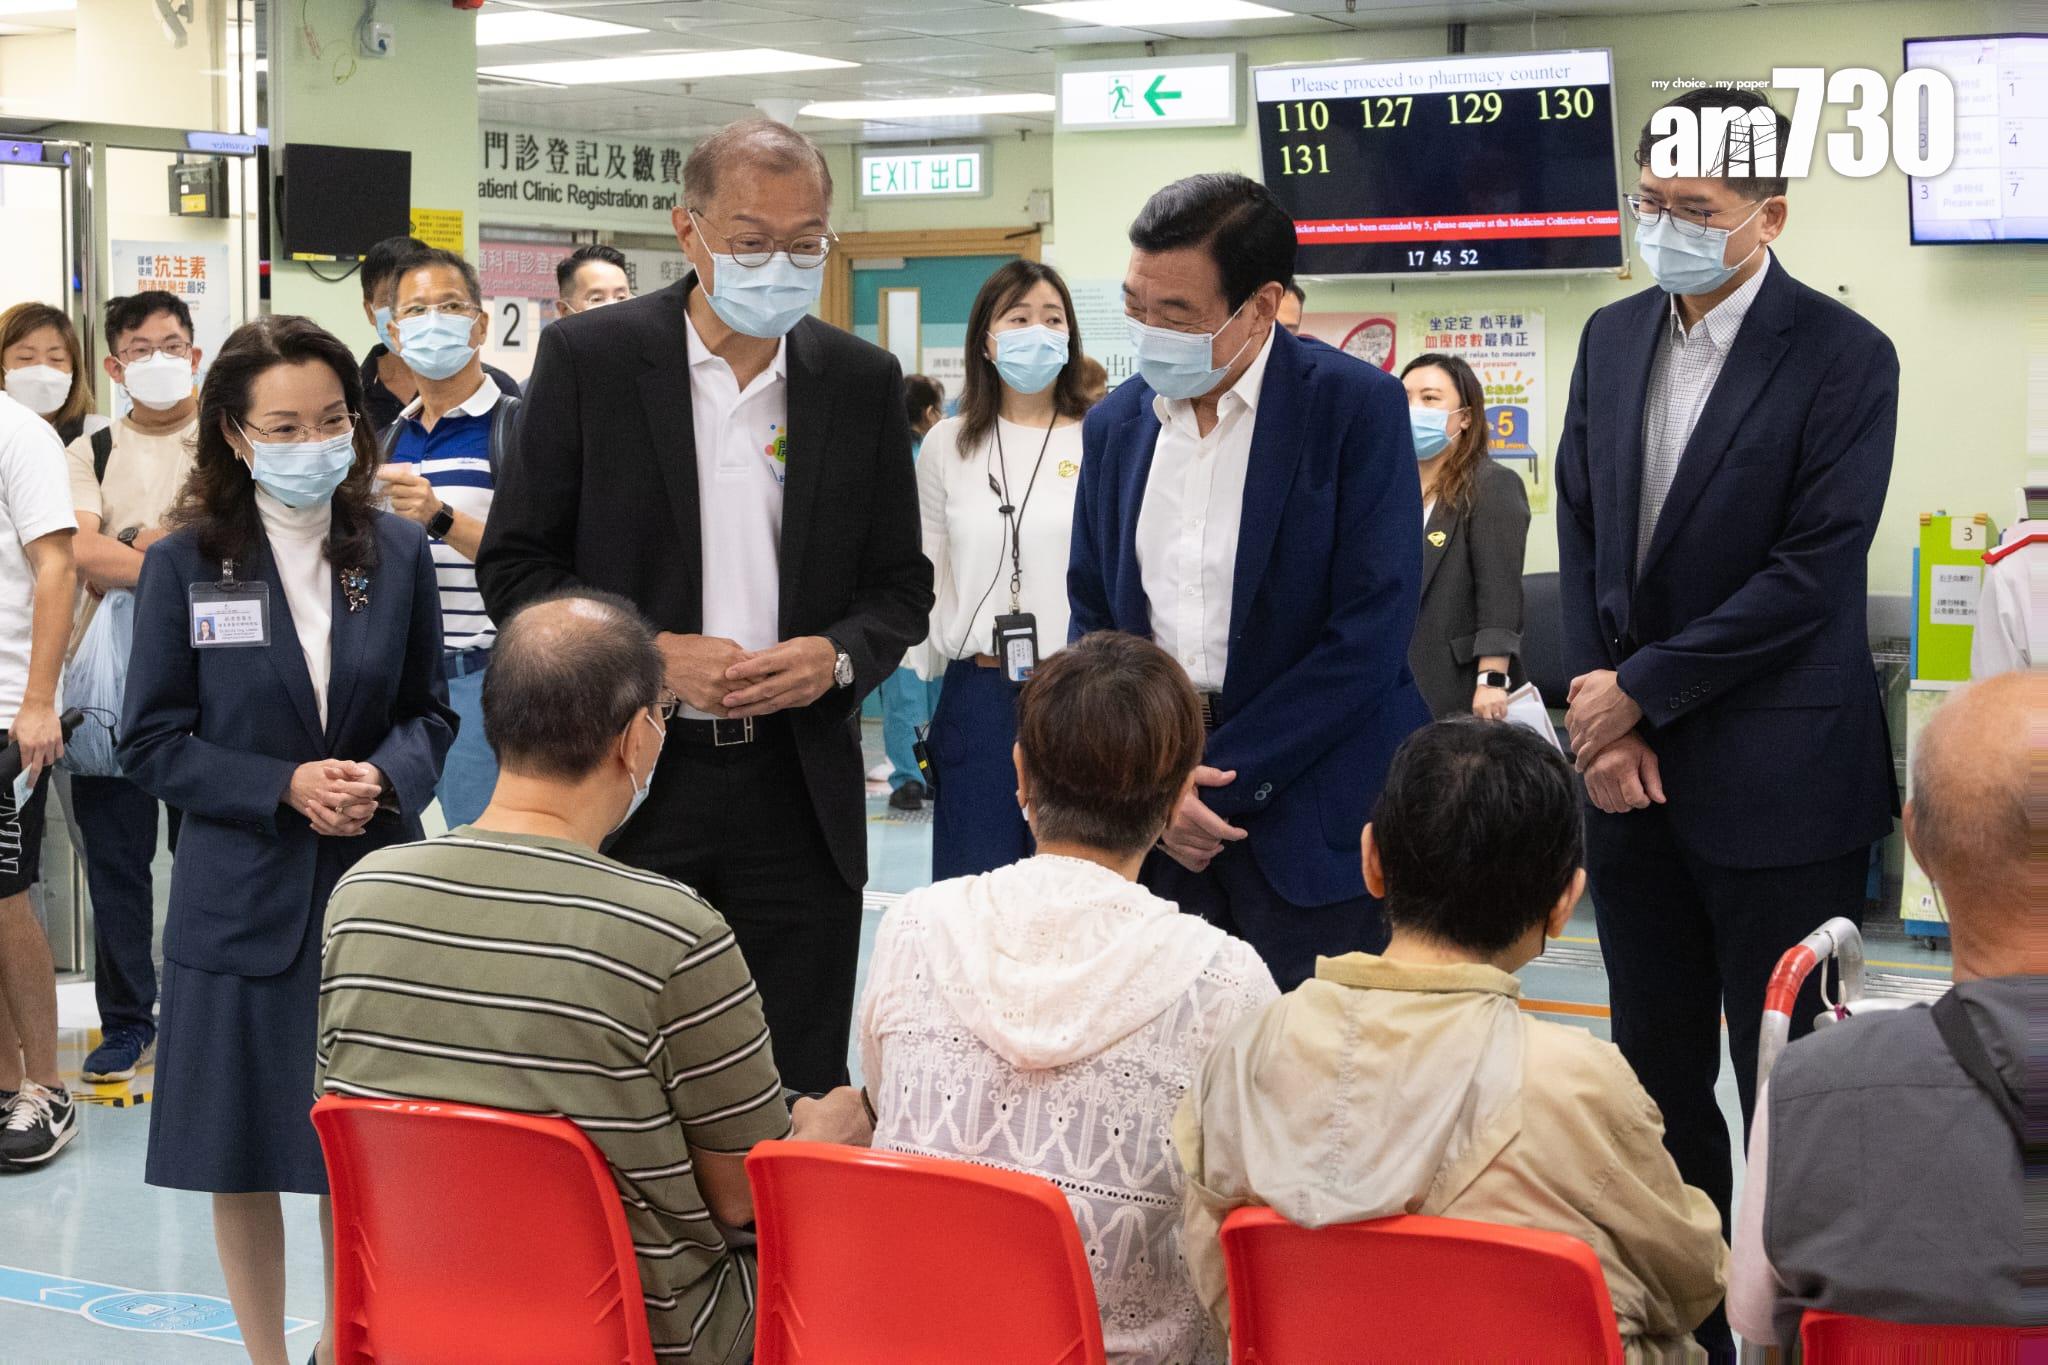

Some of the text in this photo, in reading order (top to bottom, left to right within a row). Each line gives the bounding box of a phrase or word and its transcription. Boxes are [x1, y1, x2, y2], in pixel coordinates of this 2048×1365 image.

[1291, 65, 1571, 93] Please proceed to pharmacy counter
[2009, 83, 2015, 96] 1
[1276, 87, 1595, 132] 110 127 129 130
[2008, 133, 2018, 146] 4
[1280, 144, 1330, 174] 131
[870, 158, 973, 192] EXIT 出口
[523, 180, 563, 203] Clinic
[568, 184, 648, 211] Registration
[652, 193, 676, 210] and
[1920, 185, 1929, 200] 3
[2010, 183, 2019, 197] 7
[1317, 224, 1345, 233] number
[1346, 223, 1358, 232] has
[1360, 223, 1377, 231] been
[1413, 221, 1423, 232] by
[1433, 220, 1456, 231] please
[1458, 220, 1486, 230] enquire
[1487, 219, 1495, 228] at
[1496, 218, 1508, 227] the
[1510, 217, 1545, 227] Medicine
[1547, 216, 1585, 226] Collection
[1587, 215, 1618, 224] Counter
[155, 255, 206, 279] 抗生素
[1408, 249, 1479, 266] 17 45 52
[503, 303, 521, 346] 2
[1483, 361, 1517, 369] pressure
[1498, 411, 1514, 436] 5
[1963, 528, 1973, 541] 3
